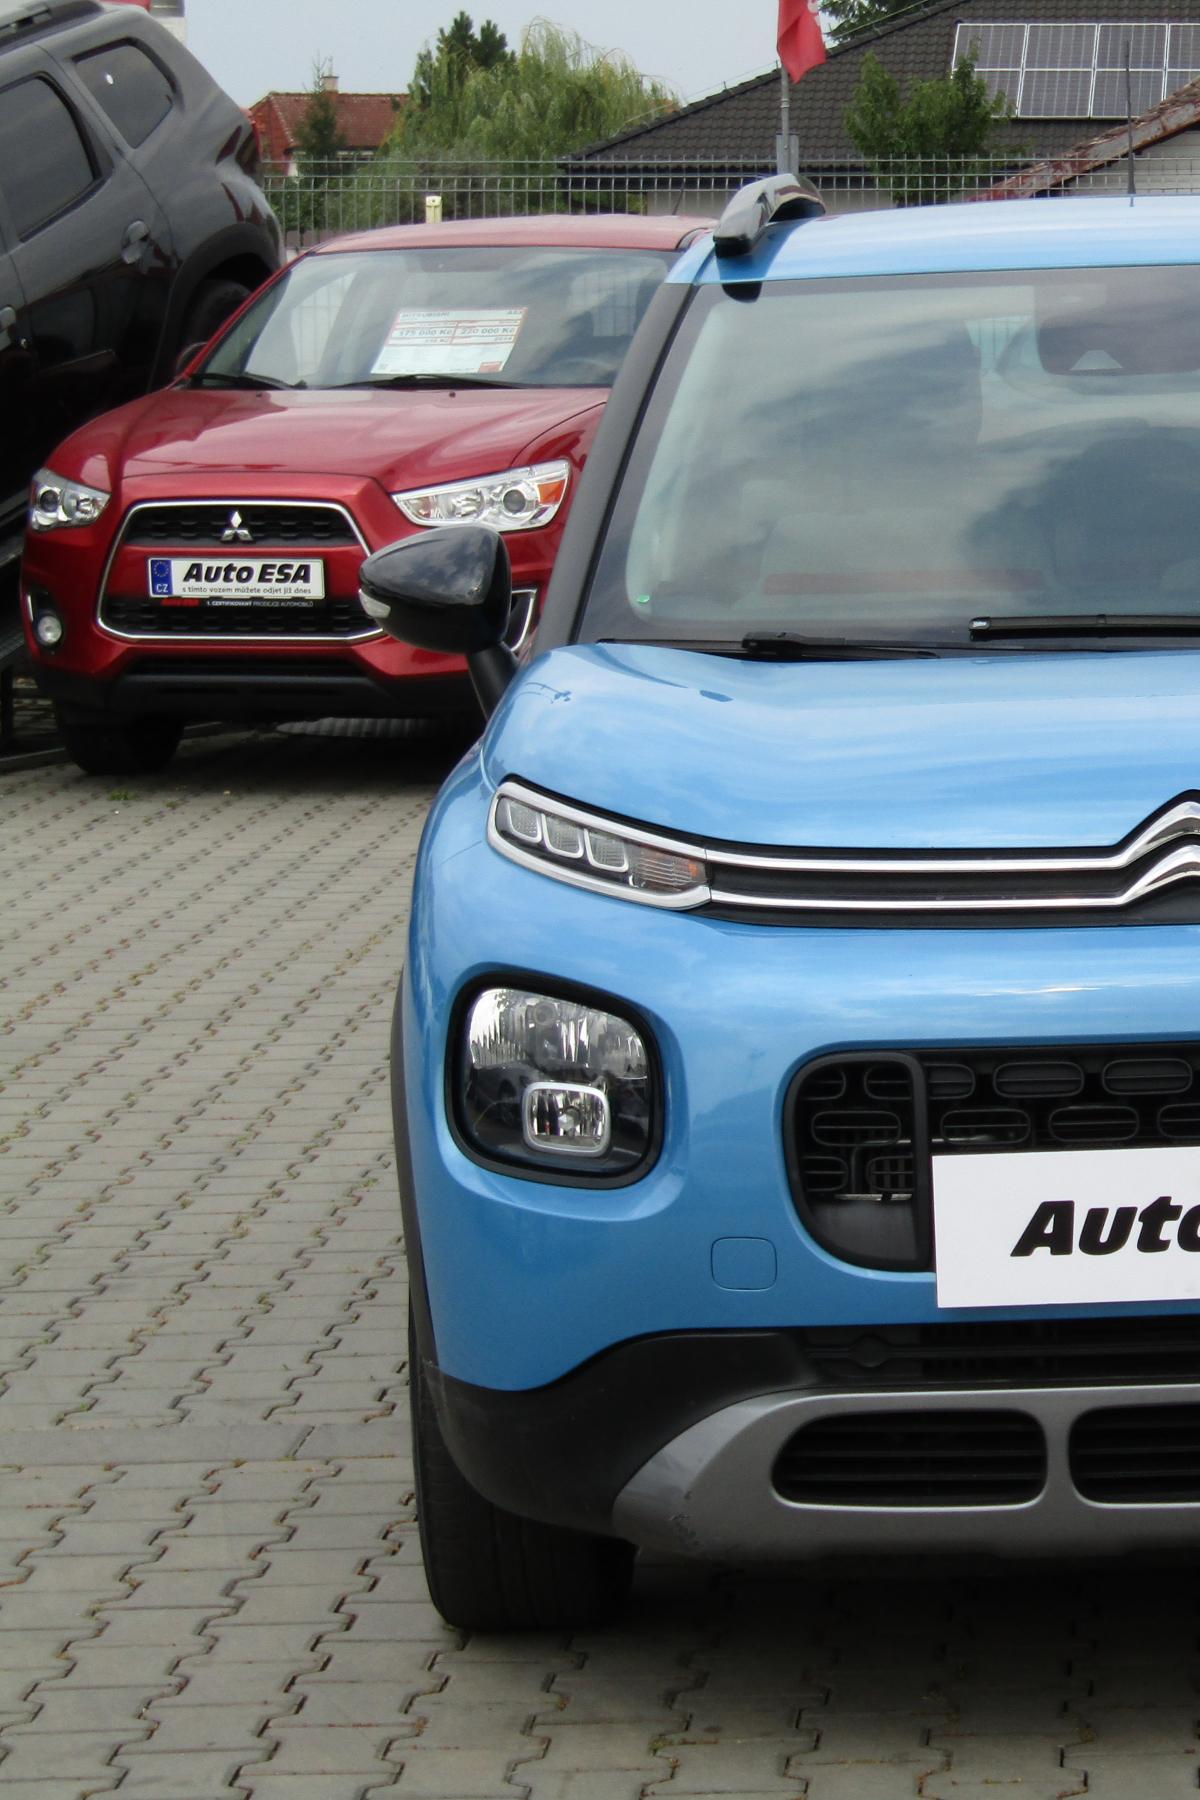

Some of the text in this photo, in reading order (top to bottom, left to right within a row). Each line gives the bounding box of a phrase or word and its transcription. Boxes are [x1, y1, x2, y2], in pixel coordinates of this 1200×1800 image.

[481, 327, 500, 335] 000
[183, 562, 312, 585] Auto ESA
[156, 584, 170, 593] CZ
[262, 587, 282, 595] odjet
[293, 587, 311, 595] dnes
